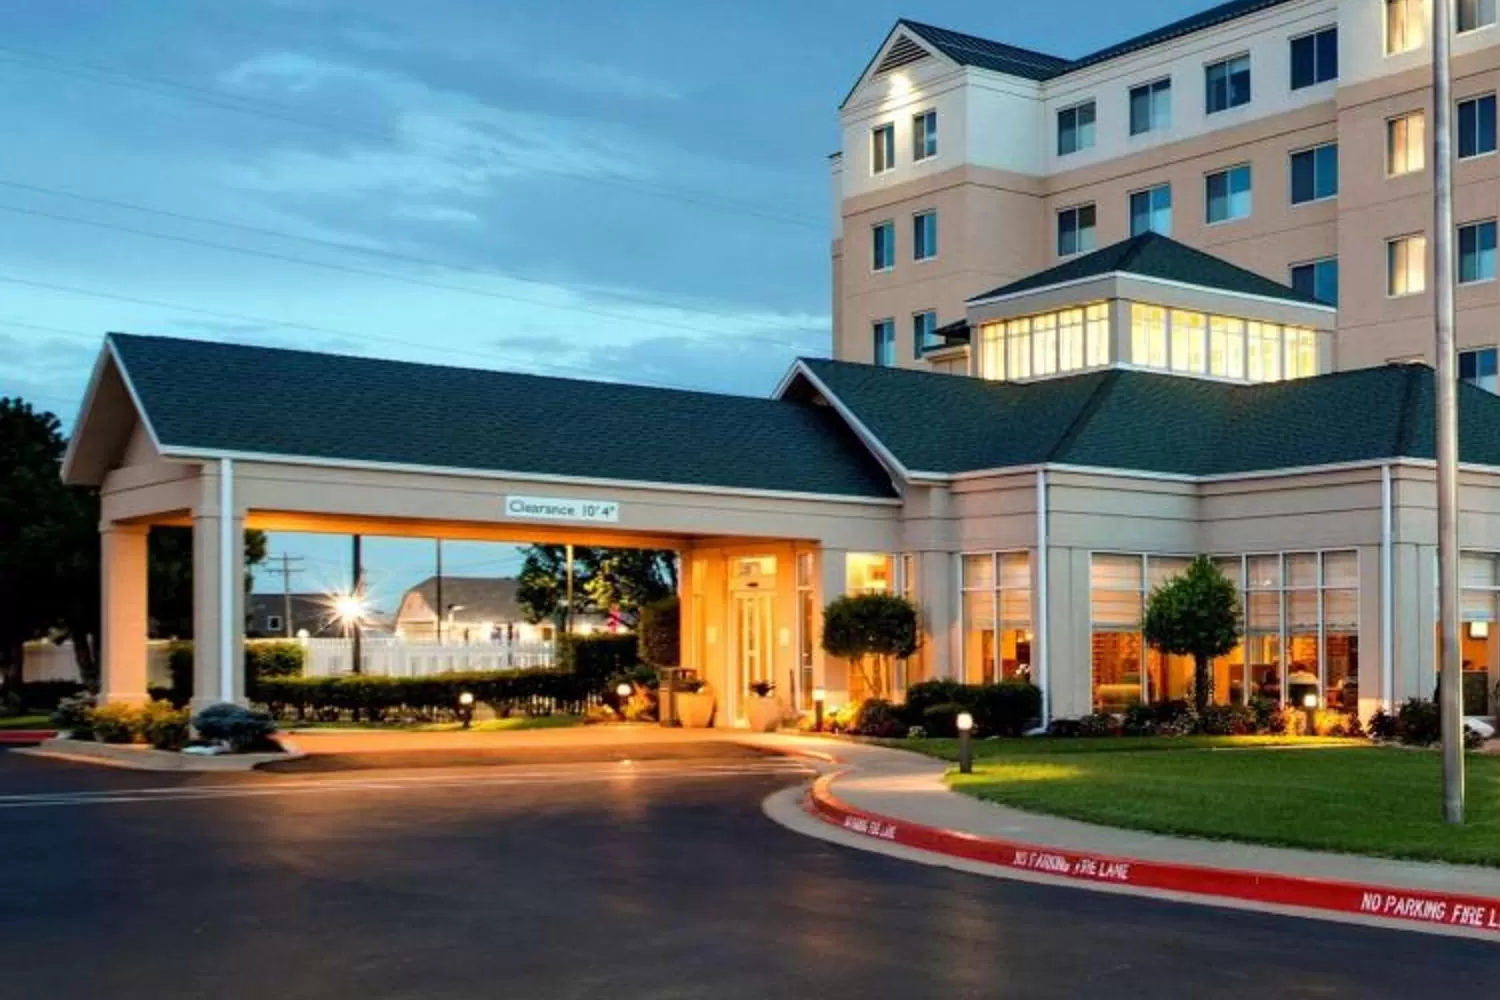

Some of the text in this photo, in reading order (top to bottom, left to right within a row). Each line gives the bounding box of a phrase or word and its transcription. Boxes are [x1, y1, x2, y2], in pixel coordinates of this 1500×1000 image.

[508, 499, 576, 516] Clearance
[1098, 861, 1129, 880] LANE
[1360, 892, 1381, 911] NO
[1384, 896, 1446, 921] PARKING
[1451, 904, 1486, 926] FIRE
